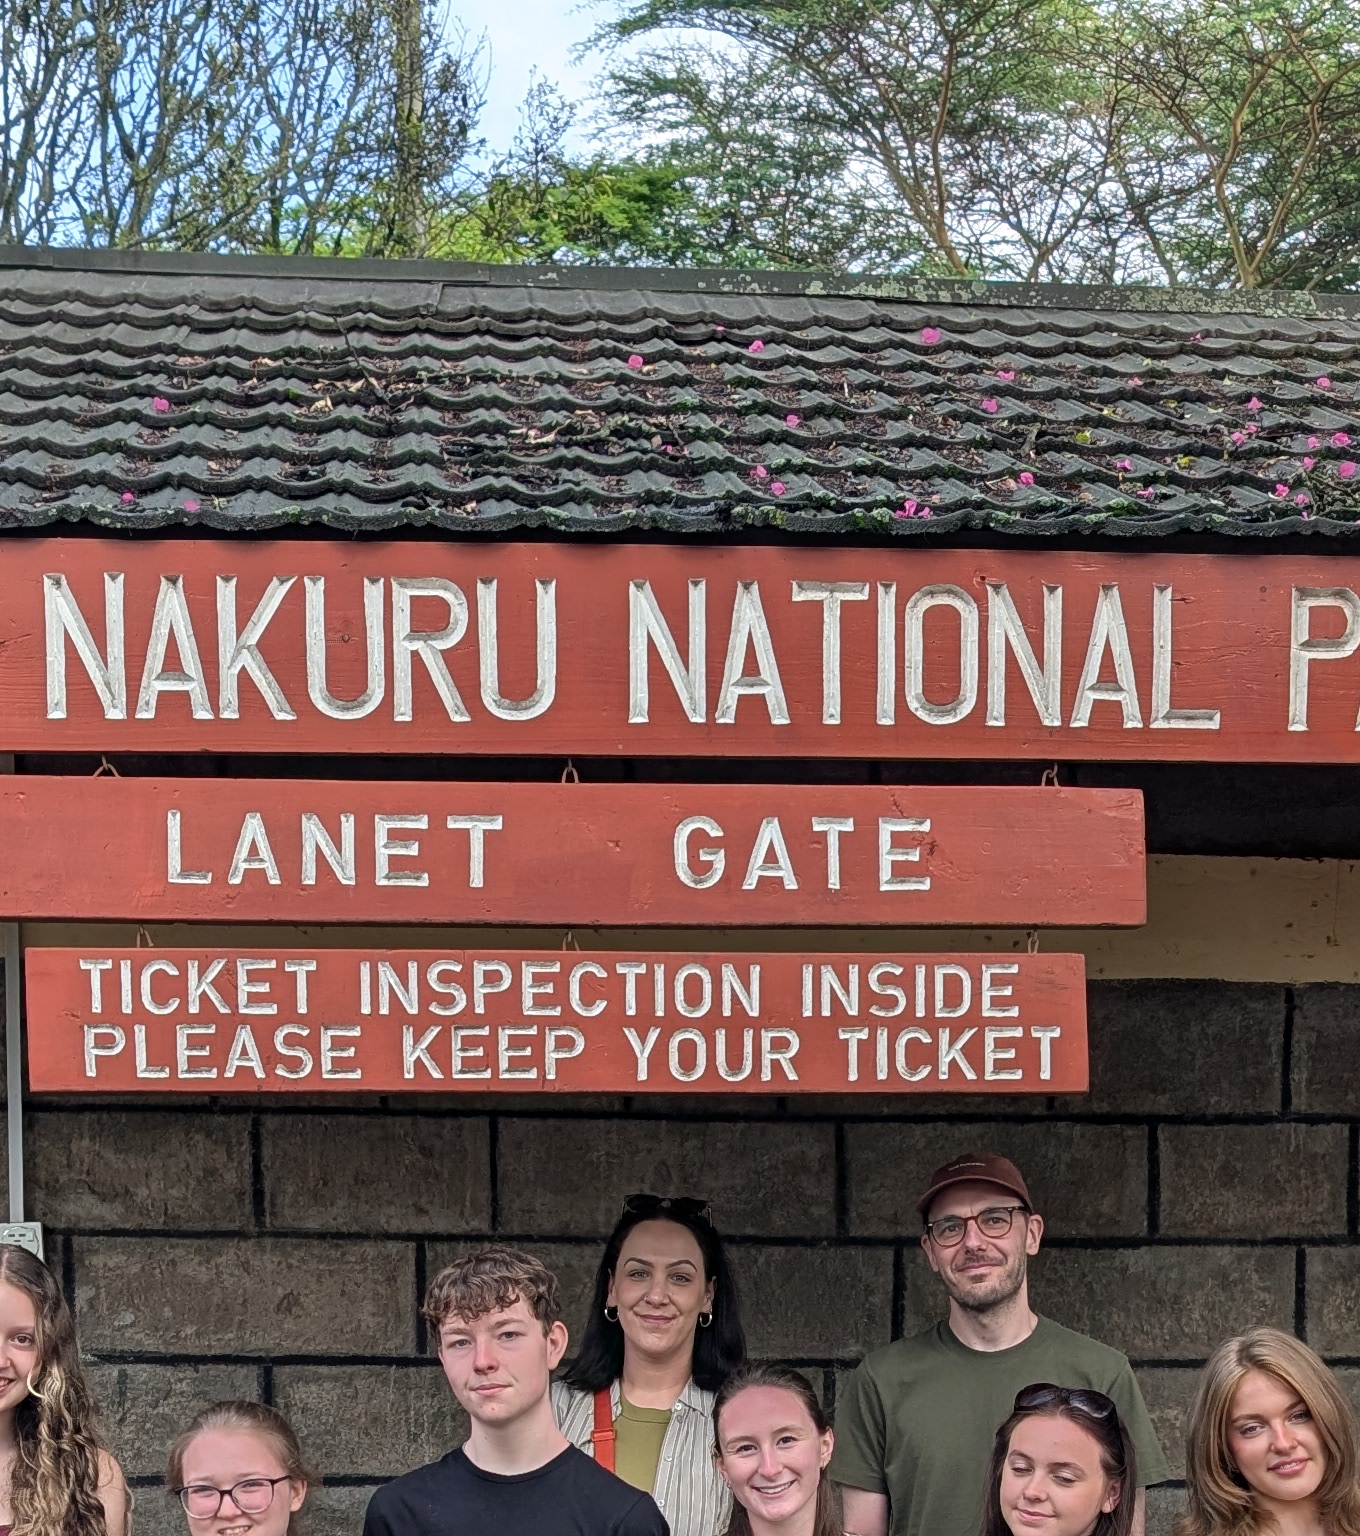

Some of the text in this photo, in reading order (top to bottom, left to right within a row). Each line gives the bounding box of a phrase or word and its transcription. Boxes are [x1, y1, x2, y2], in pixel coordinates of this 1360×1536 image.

[43, 571, 556, 722] NAKURU
[628, 578, 1220, 729] NATIONAL
[167, 809, 931, 891] LANET GATE
[79, 958, 1019, 1017] TICKET INSPECTION INSIDE
[84, 1024, 1060, 1081] PLEASE KEEP YOUR TICKET
